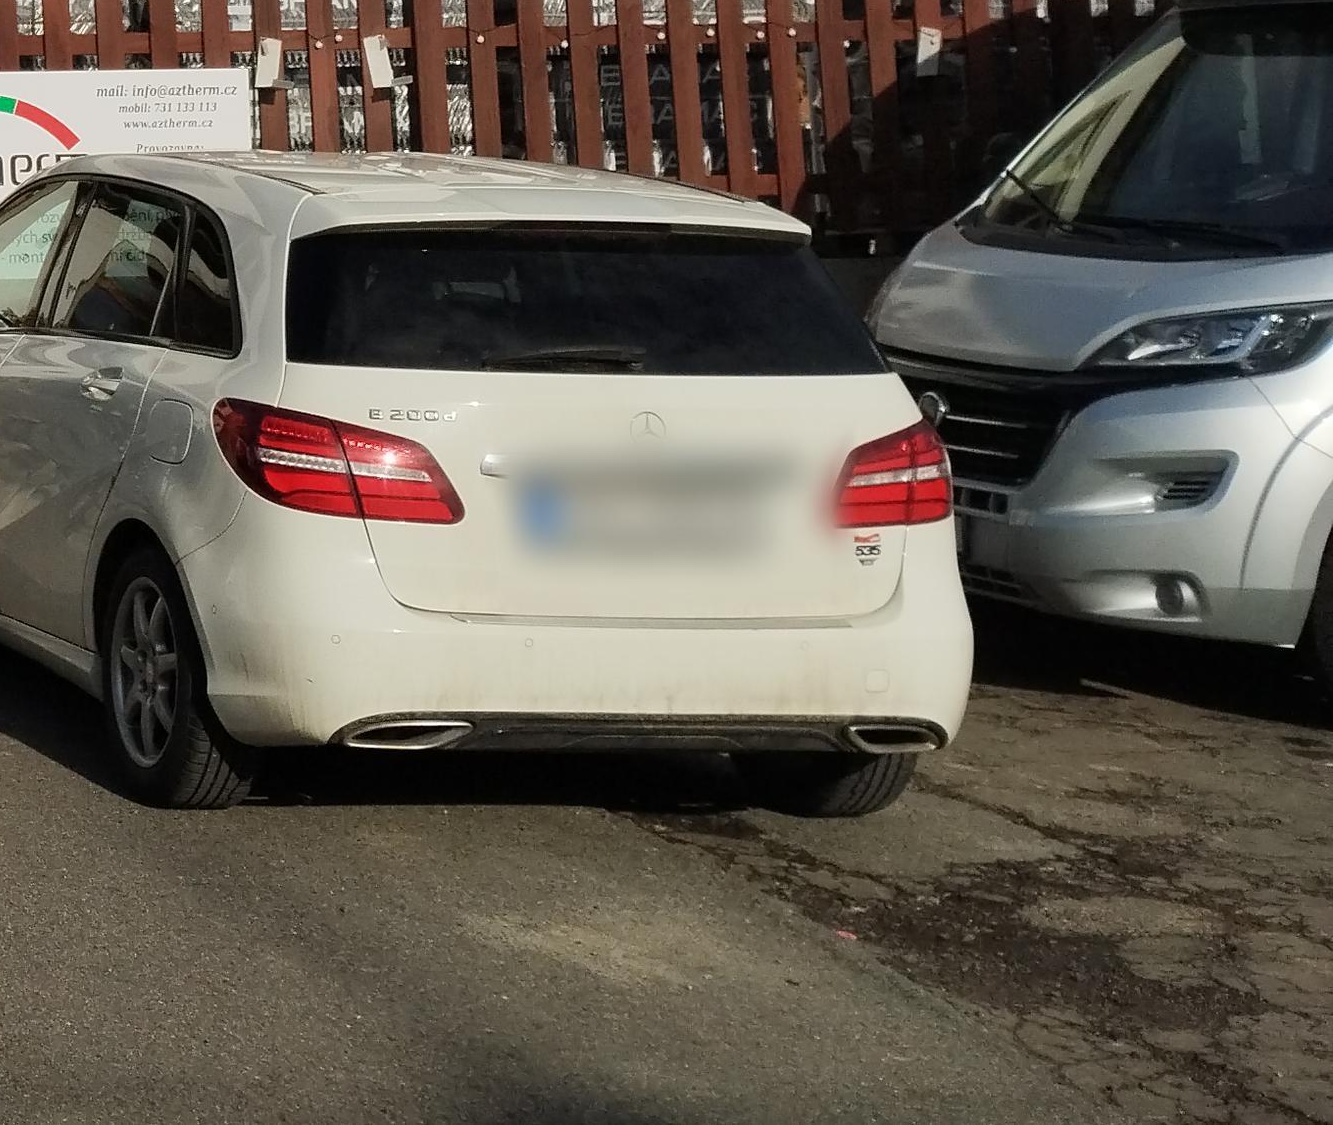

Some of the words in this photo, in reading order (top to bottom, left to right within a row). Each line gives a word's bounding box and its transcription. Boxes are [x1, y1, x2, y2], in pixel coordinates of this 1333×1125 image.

[96, 84, 129, 98] mail:
[132, 83, 238, 99] info@aztherm.cz
[118, 102, 151, 114] mobil:
[154, 102, 173, 113] 731
[176, 102, 195, 113] 133
[199, 101, 218, 112] 113
[123, 118, 214, 129] www.aztherm.cz
[389, 409, 440, 422] 200
